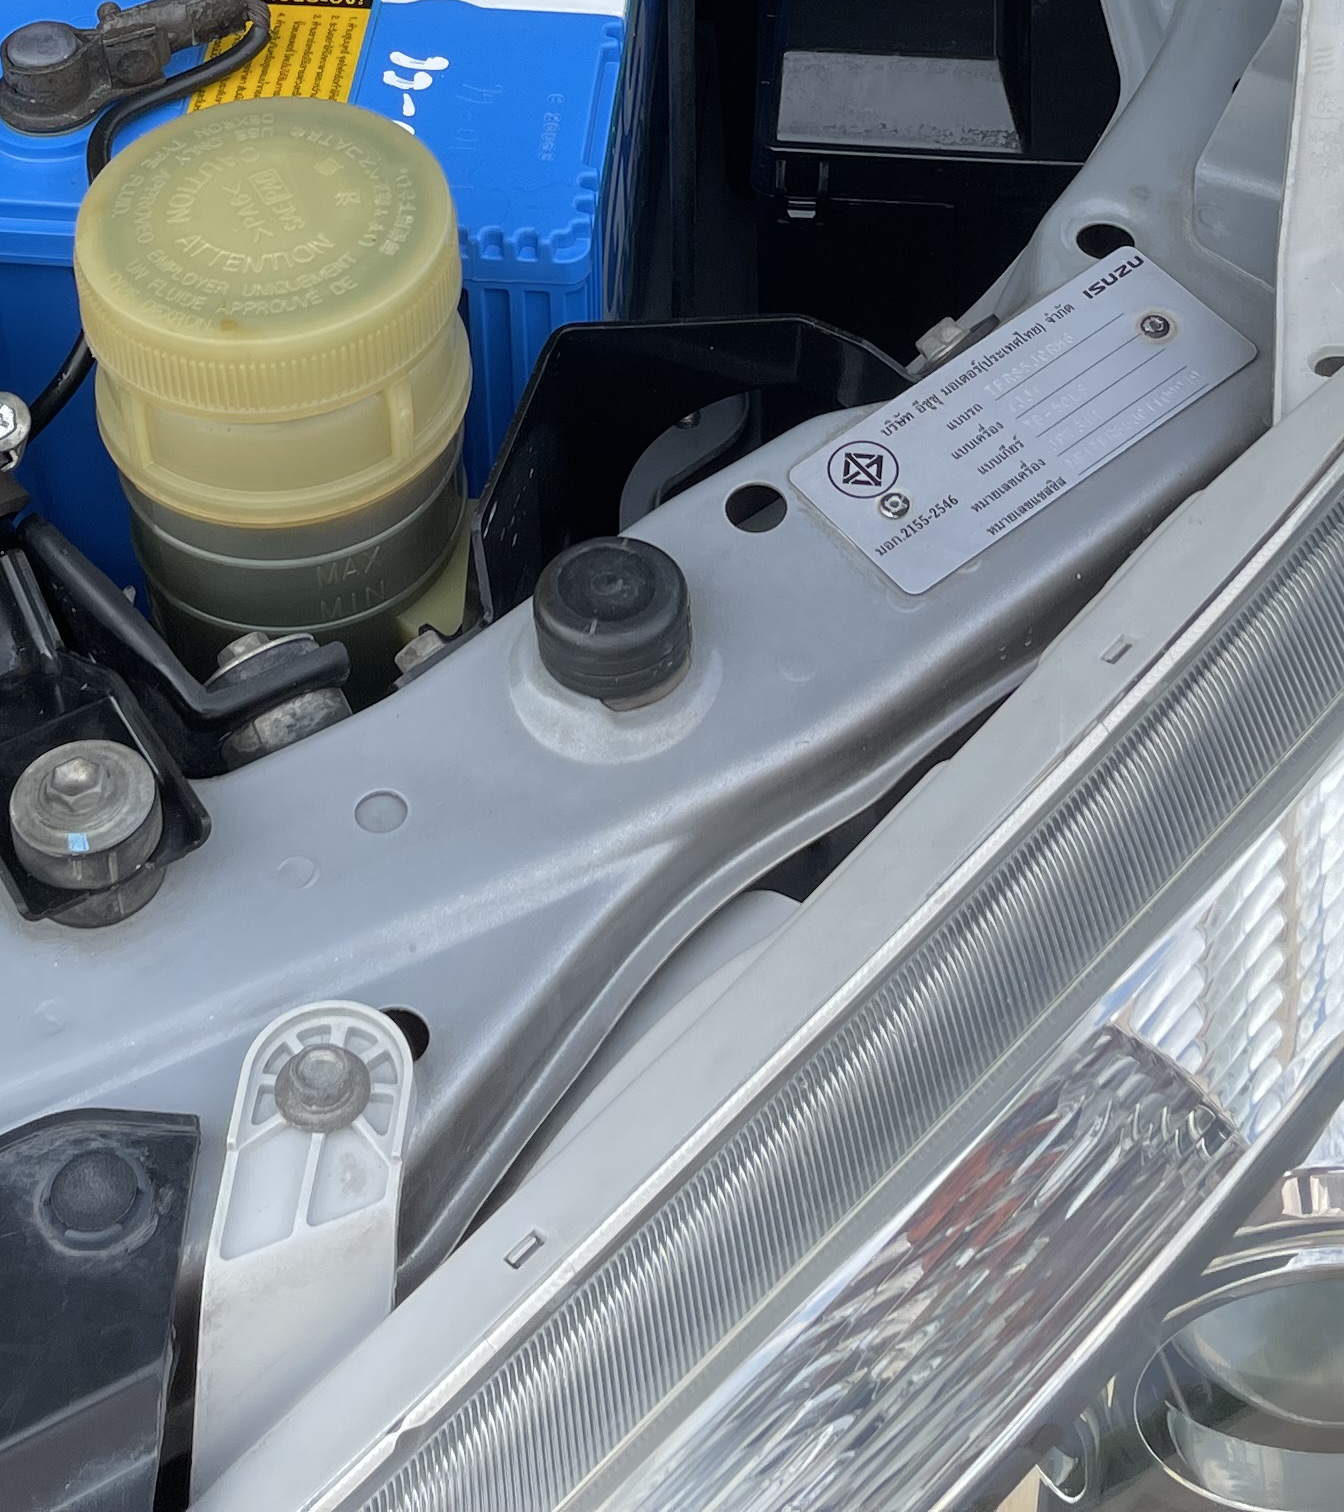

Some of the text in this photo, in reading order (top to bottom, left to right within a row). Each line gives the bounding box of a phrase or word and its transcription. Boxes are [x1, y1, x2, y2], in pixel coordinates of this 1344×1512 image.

[196, 113, 274, 139] DEXRON
[142, 139, 188, 168] TYPE
[134, 126, 274, 243] USE ONLY APPROVED
[166, 147, 260, 225] CAUTION
[147, 248, 357, 297] EMPLOYER UNIQUEMENT
[174, 232, 335, 273] ATTENTION
[125, 259, 150, 280] UN
[150, 281, 210, 310] FLUIDE
[329, 276, 359, 296] DE
[1082, 255, 1144, 300] ISUZU
[880, 301, 1076, 438] บริษัท อีซูซุ มอเตอร์(ประเทศไทย) จำกัด
[945, 402, 983, 431] แบบรถ
[951, 420, 1004, 460] แบบเครื่อง
[977, 435, 1025, 476] แบบเกียร์
[970, 456, 1047, 513] หมายเลขเครื่อง
[874, 495, 959, 557] มอก.2155-2546
[316, 544, 381, 587] MAX
[320, 579, 385, 620] MIN
